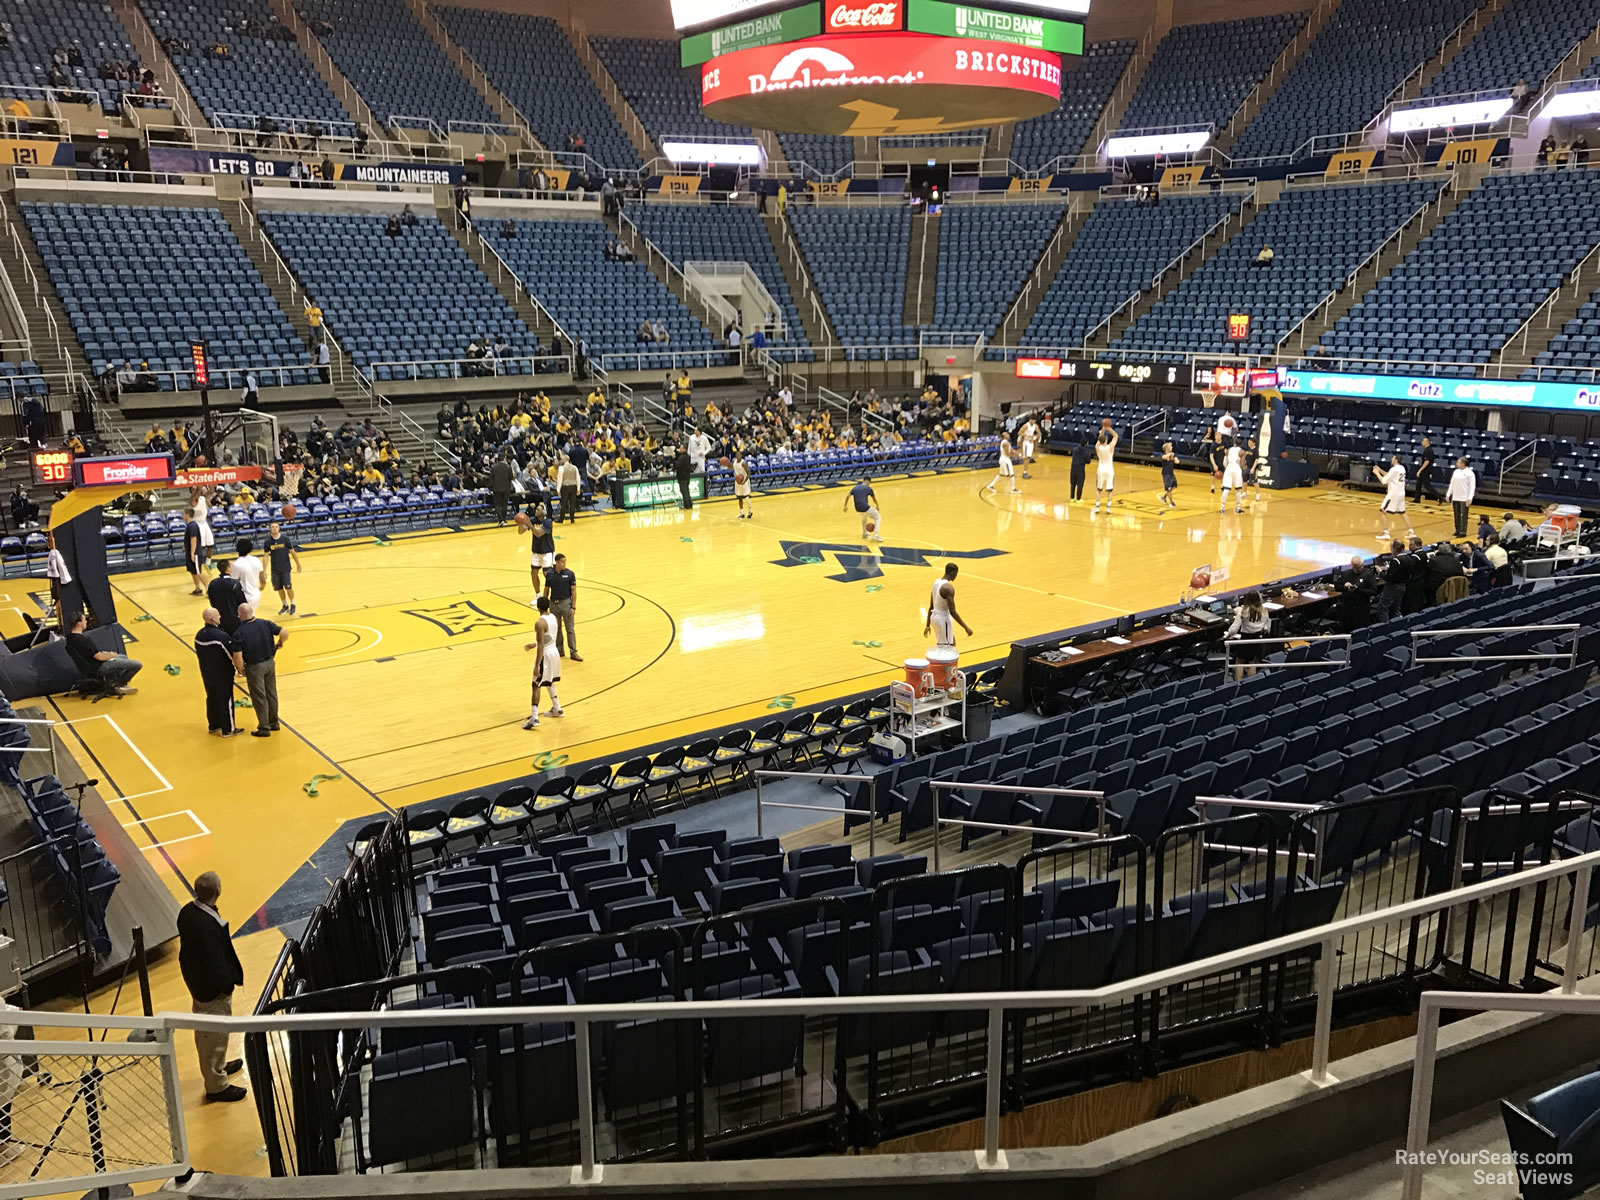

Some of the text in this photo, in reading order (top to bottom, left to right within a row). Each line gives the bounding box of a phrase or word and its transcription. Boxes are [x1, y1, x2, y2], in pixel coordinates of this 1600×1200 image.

[830, 2, 898, 27] Coca-Cola
[720, 14, 782, 44] UNITED BANK
[967, 9, 1044, 36] UNITED BANK
[954, 50, 1060, 86] BRICKSTREET
[12, 147, 38, 164] 121
[1456, 148, 1478, 164] 101
[209, 158, 275, 176] LET'S GO
[1339, 159, 1362, 174] 128
[356, 166, 450, 184] MOUNTAINEERS
[1172, 173, 1192, 186] 127
[670, 182, 689, 193] 124
[818, 184, 838, 196] 125
[1231, 325, 1246, 336] 30
[1119, 364, 1151, 378] 60:00
[43, 465, 66, 480] 30
[103, 467, 148, 478] Frontier
